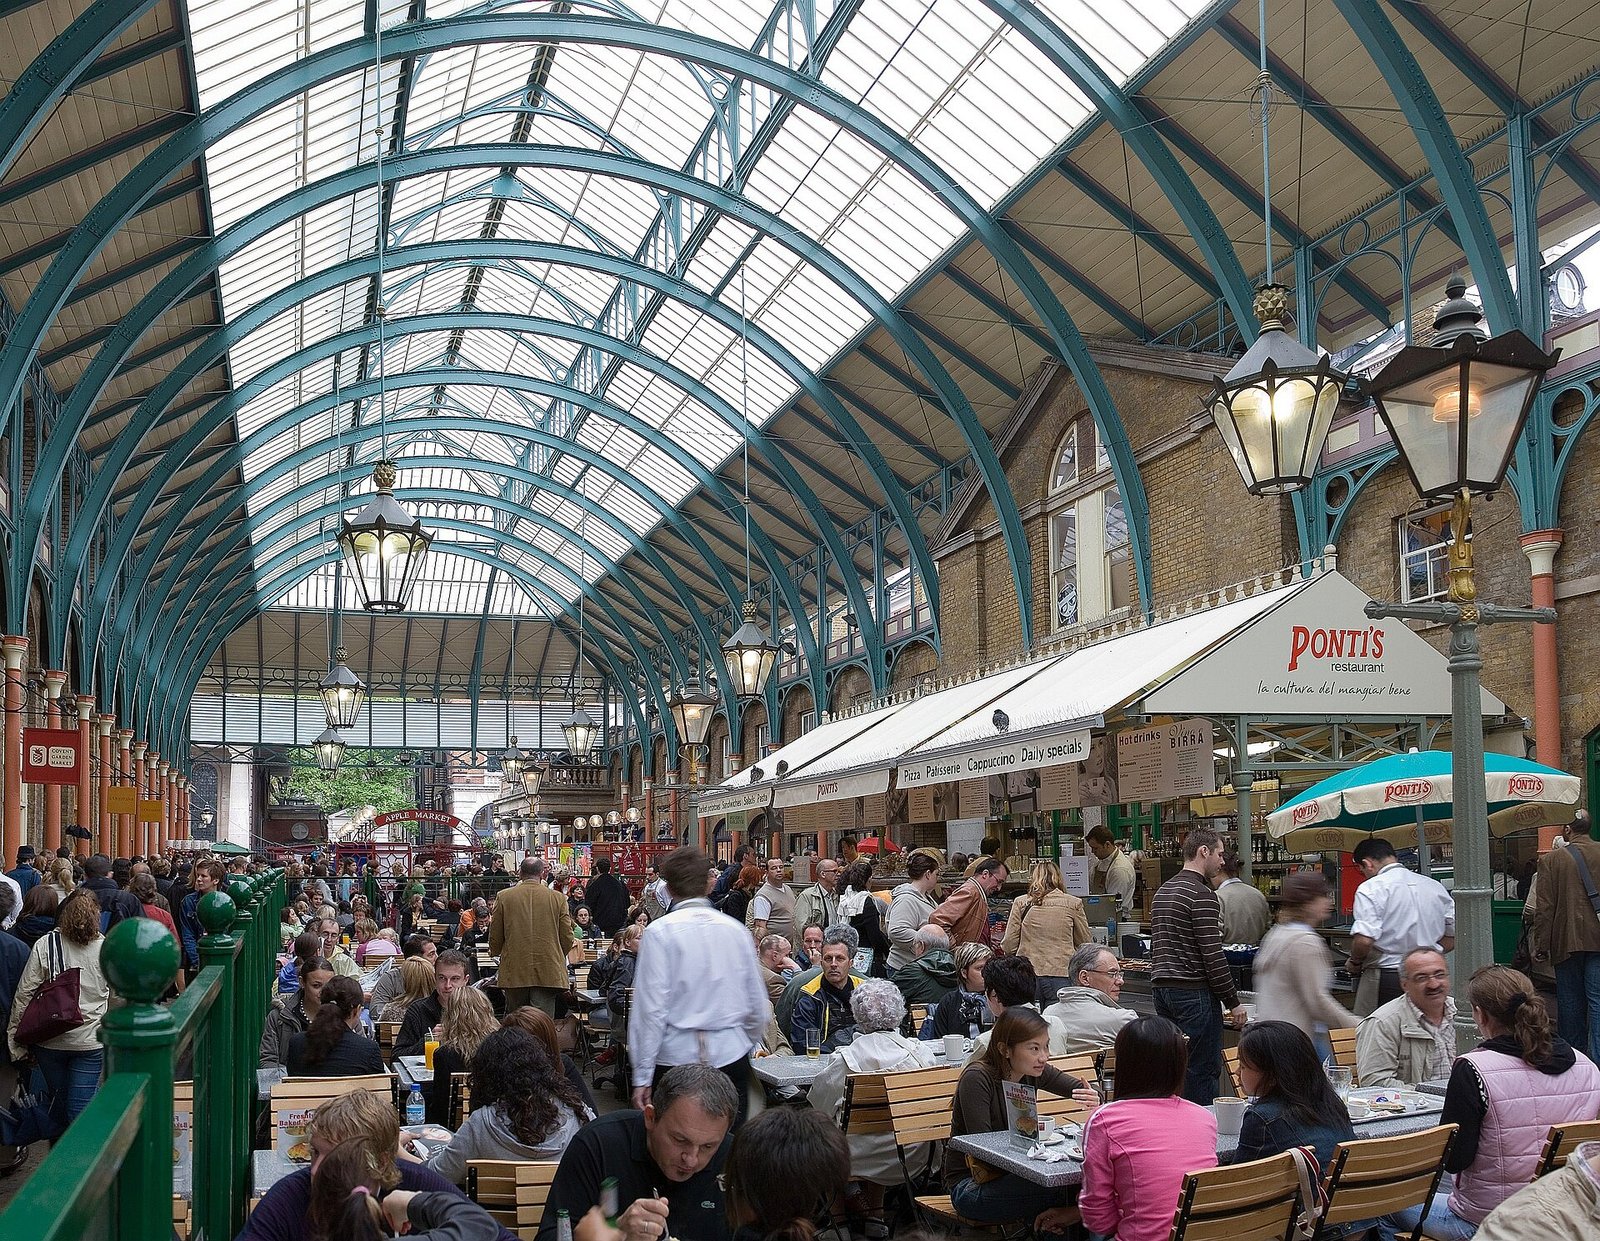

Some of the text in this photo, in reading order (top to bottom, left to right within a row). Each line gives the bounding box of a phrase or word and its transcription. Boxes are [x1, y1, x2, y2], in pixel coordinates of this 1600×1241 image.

[1288, 625, 1385, 672] PONTI'S
[1331, 662, 1385, 673] restaurant
[1258, 680, 1412, 701] la cultura del mangiar bene
[1118, 730, 1161, 746] Hot drinks
[1169, 733, 1204, 748] BIRRA
[904, 738, 1082, 783] Pizza Patisserie Cappuccino Daily specials
[816, 782, 839, 800] PONTI'S
[1384, 779, 1432, 802] PONTI'S
[1507, 778, 1543, 796] PONTI'S
[722, 798, 742, 810] Sandwiches
[744, 795, 756, 806] Salads
[757, 793, 768, 803] Pasta
[385, 811, 452, 824] APPLE MARKET
[1292, 800, 1319, 826] PONTI'S
